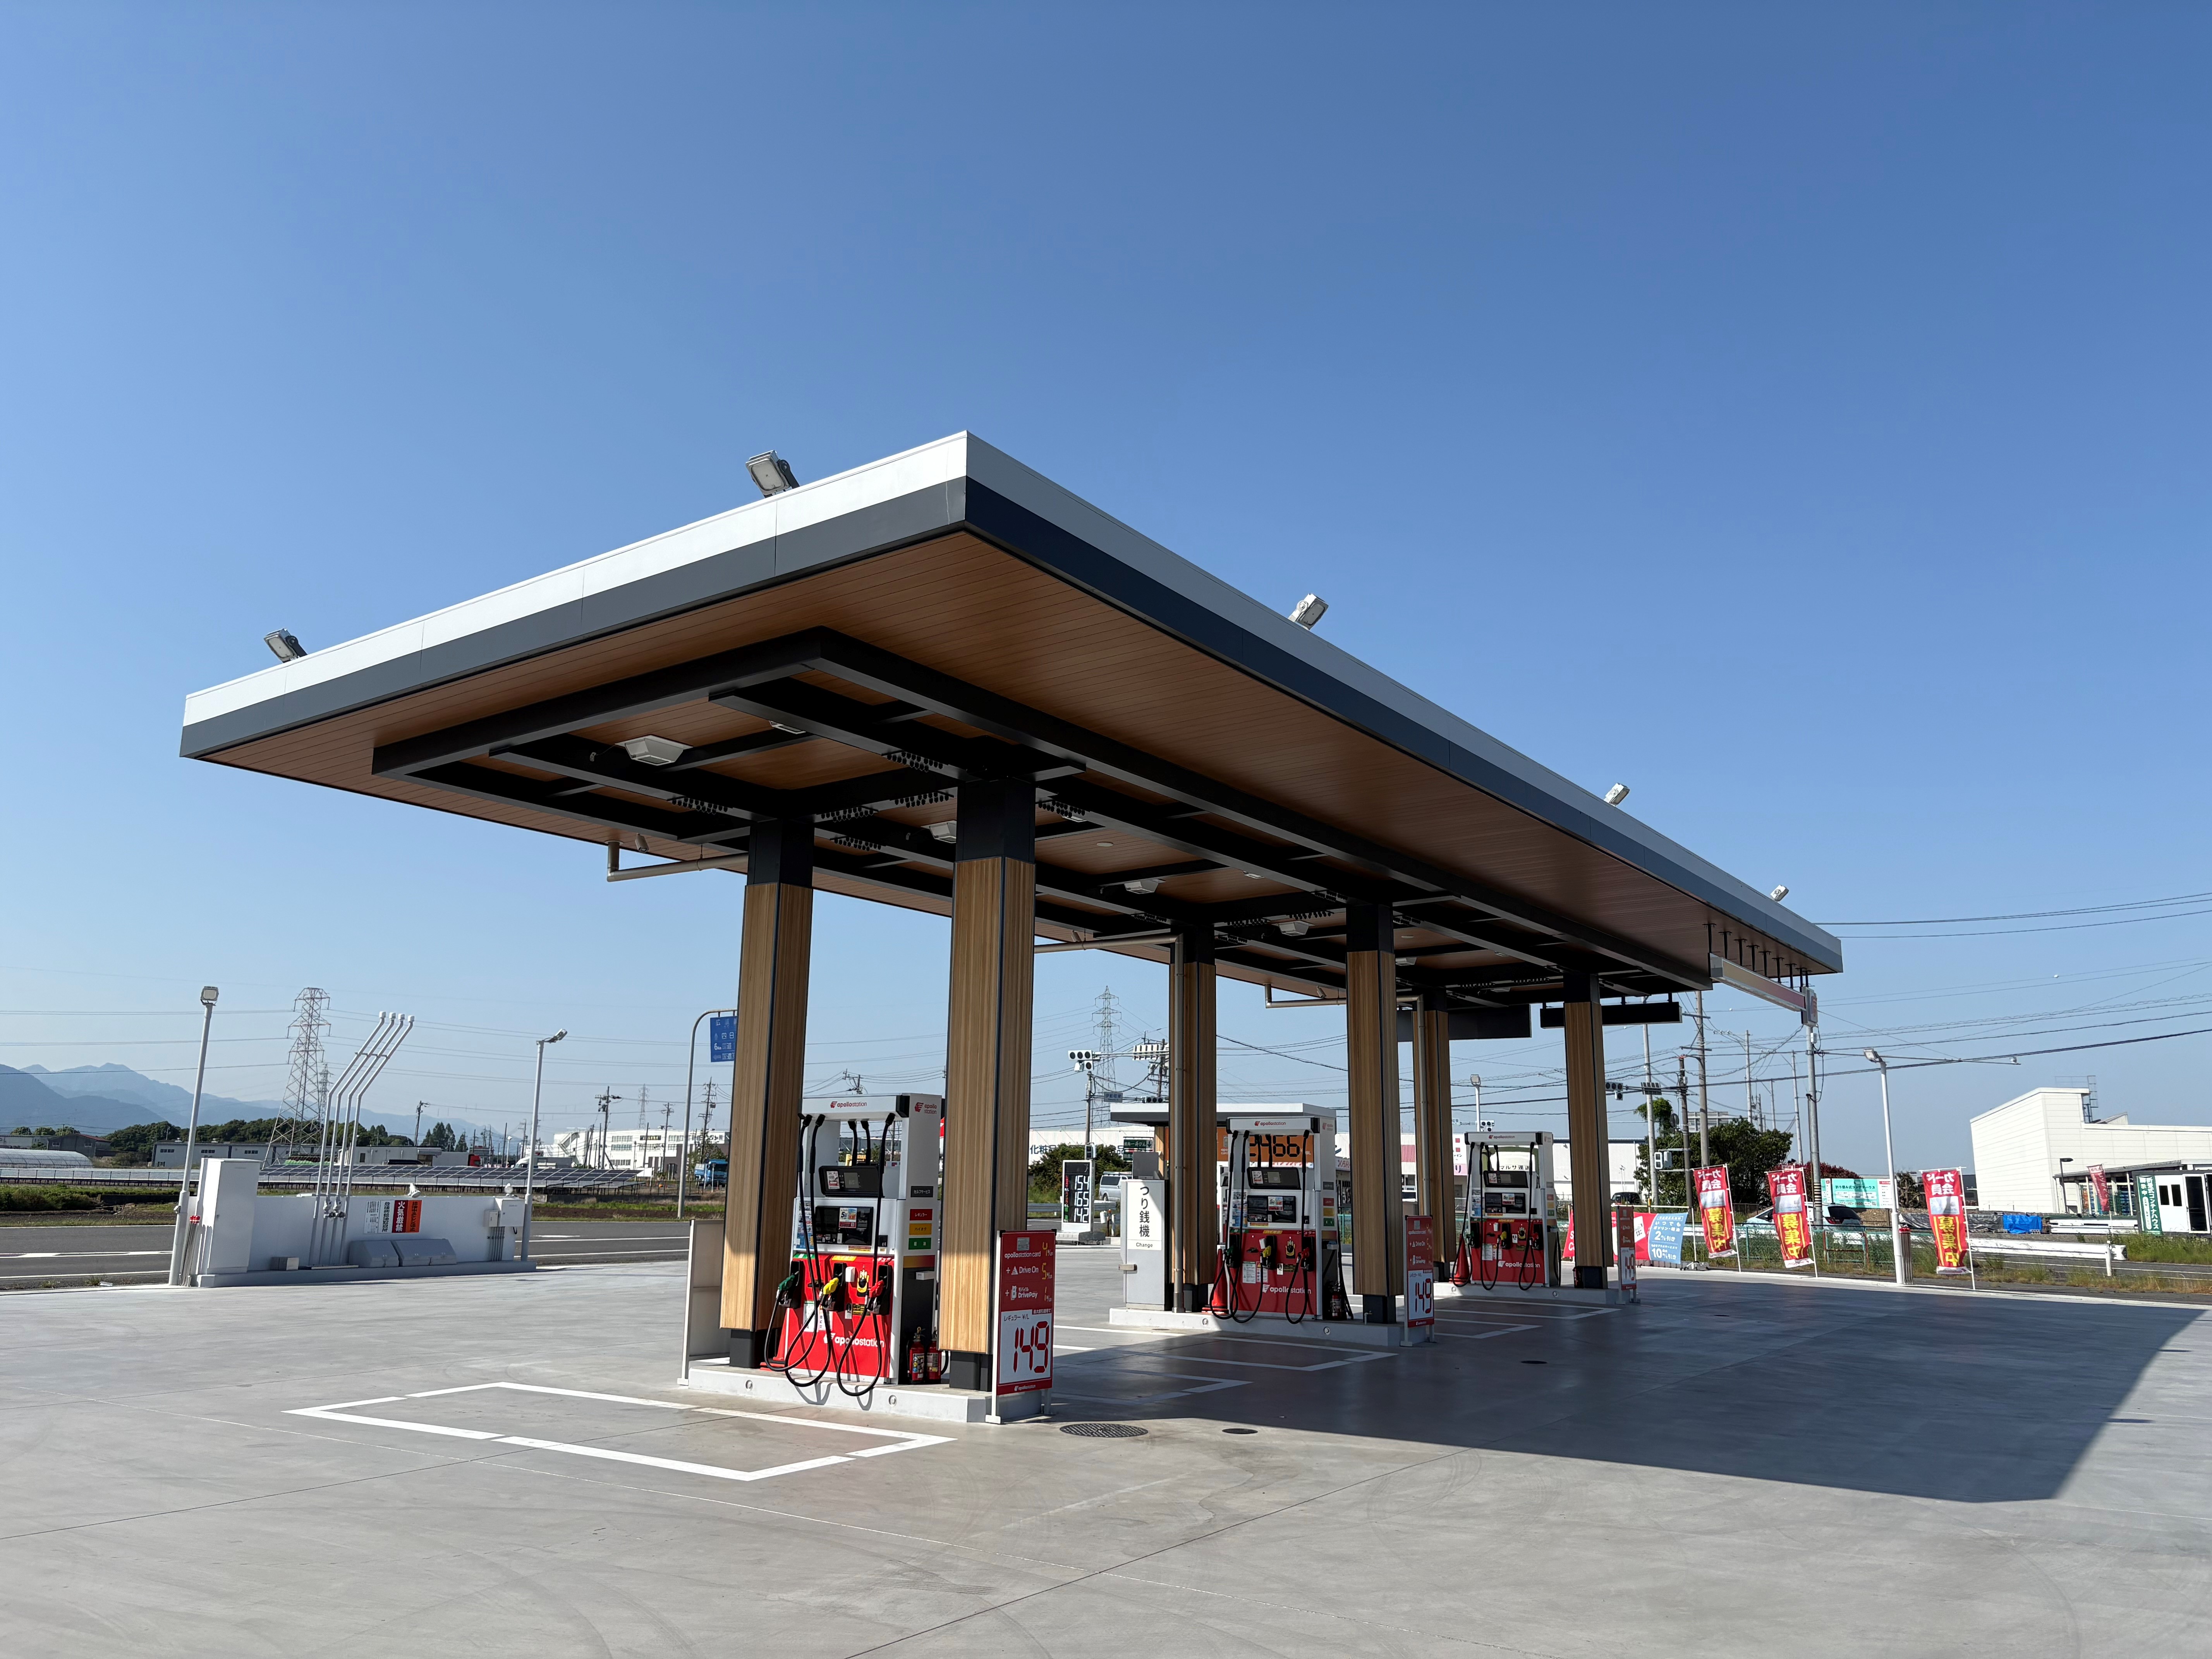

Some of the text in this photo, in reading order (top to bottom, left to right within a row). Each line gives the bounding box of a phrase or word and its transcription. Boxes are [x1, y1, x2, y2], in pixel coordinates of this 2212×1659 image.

[1075, 1175, 1090, 1190] 154
[1074, 1192, 1089, 1206] 165
[1139, 1186, 1149, 1237] つり銭機
[396, 1201, 405, 1231] 火気厳禁
[1074, 1207, 1089, 1223] 142
[1415, 1278, 1432, 1314] 149
[1013, 1321, 1049, 1373] 149
